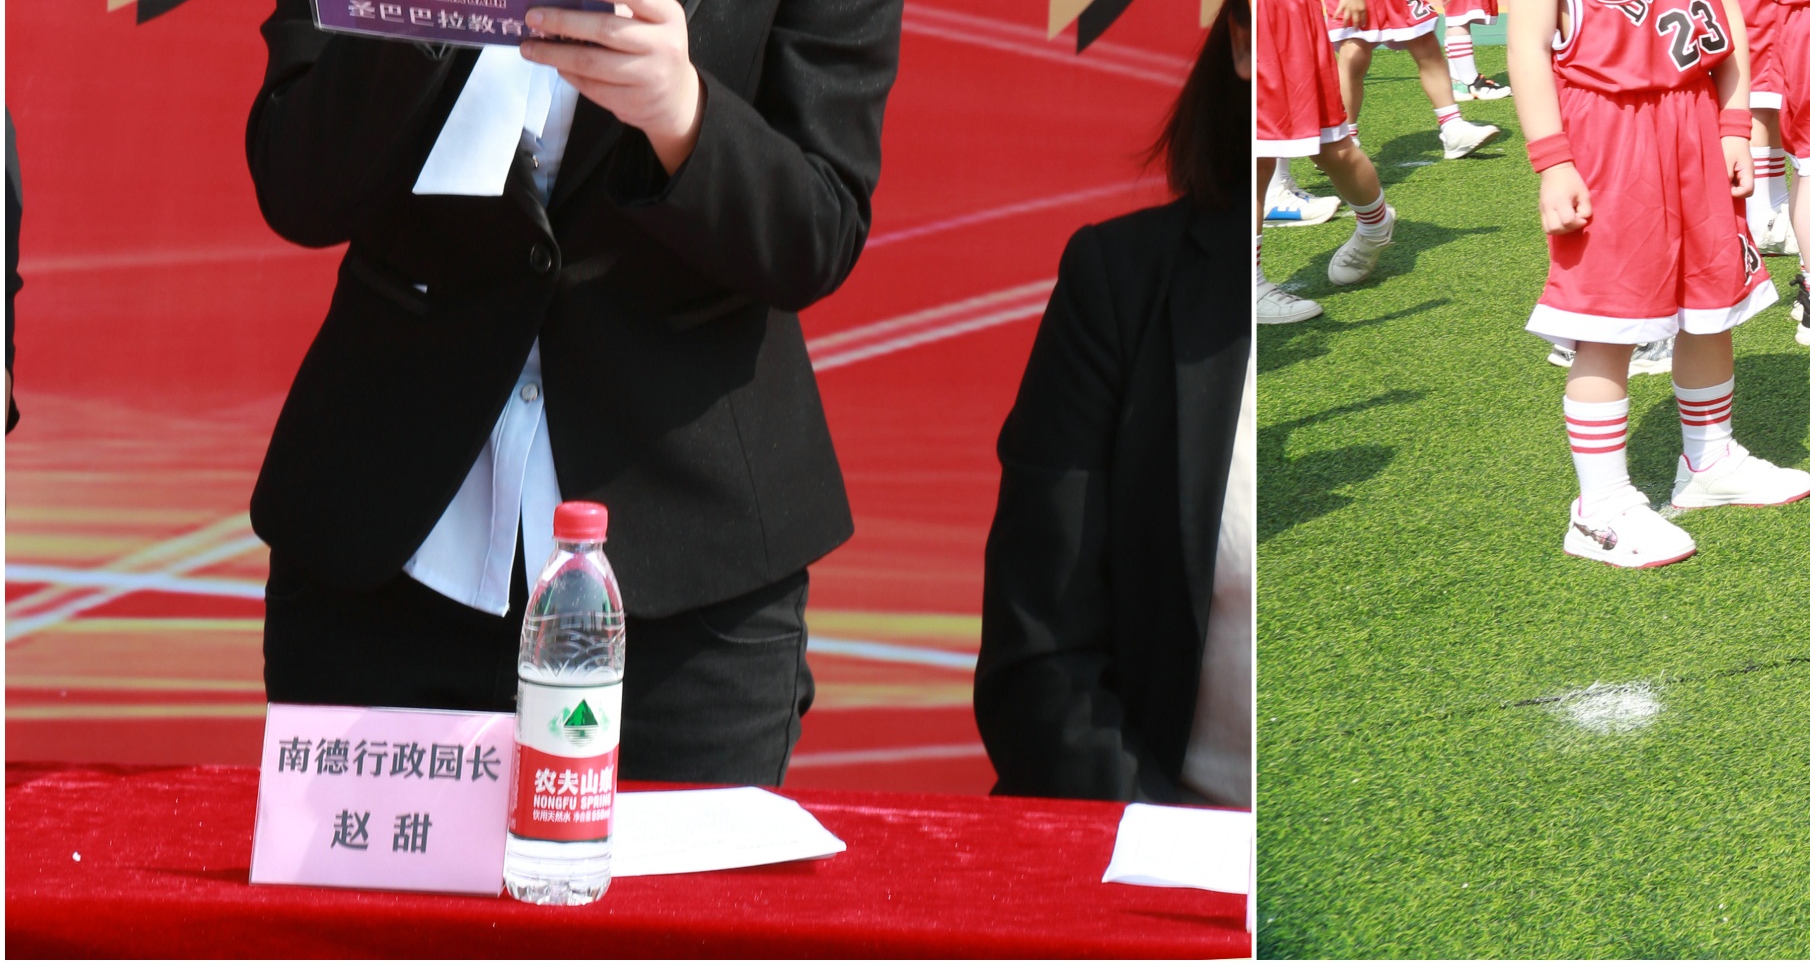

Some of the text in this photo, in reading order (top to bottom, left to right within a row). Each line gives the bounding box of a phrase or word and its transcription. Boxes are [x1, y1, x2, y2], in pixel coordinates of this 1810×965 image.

[277, 736, 501, 783] 南德行政园长
[534, 764, 615, 796] 农夫山泉
[533, 793, 612, 810] NONGFU SPRING
[532, 809, 571, 823] 饮用天然水
